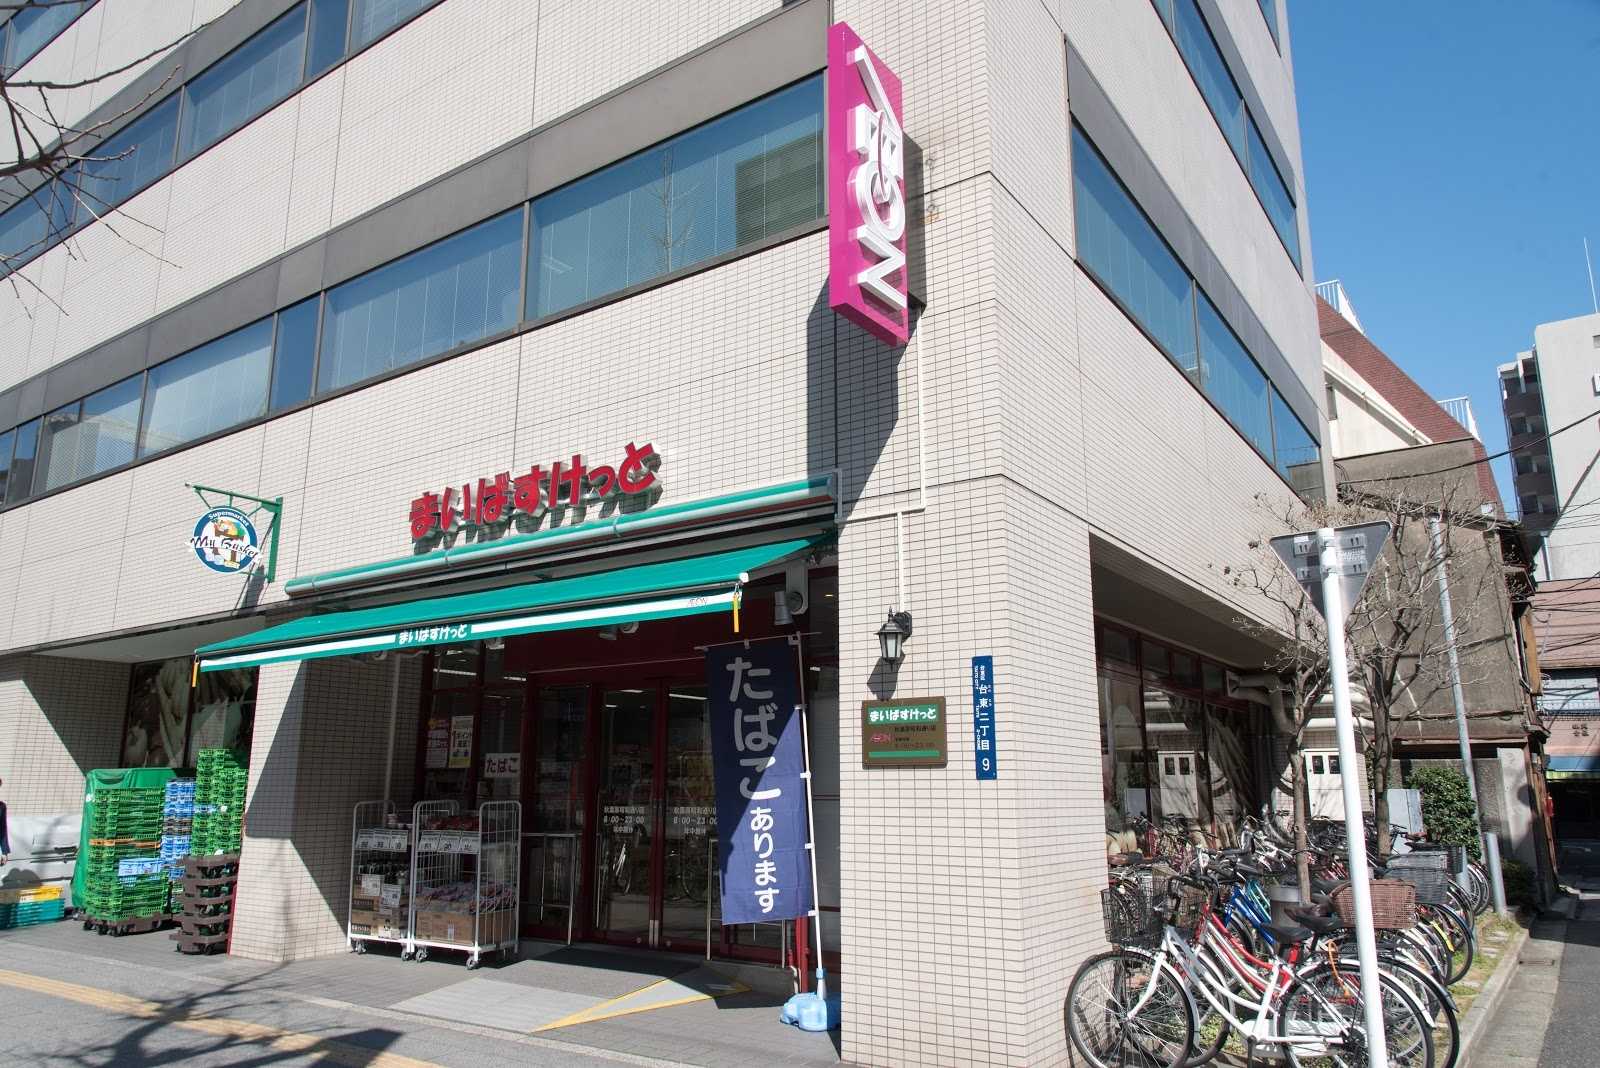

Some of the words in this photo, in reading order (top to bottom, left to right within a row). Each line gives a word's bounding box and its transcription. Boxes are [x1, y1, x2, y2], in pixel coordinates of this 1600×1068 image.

[409, 441, 656, 538] まいばすけっと
[208, 511, 249, 526] Supermarket
[190, 535, 216, 549] My
[398, 625, 468, 645] まいばすけっと
[869, 707, 937, 723] まいばすけっと
[979, 684, 990, 751] 台東二丁目
[726, 657, 782, 800] たばこ
[487, 757, 518, 773] たばこ
[982, 758, 990, 771] 9
[749, 806, 780, 914] あります
